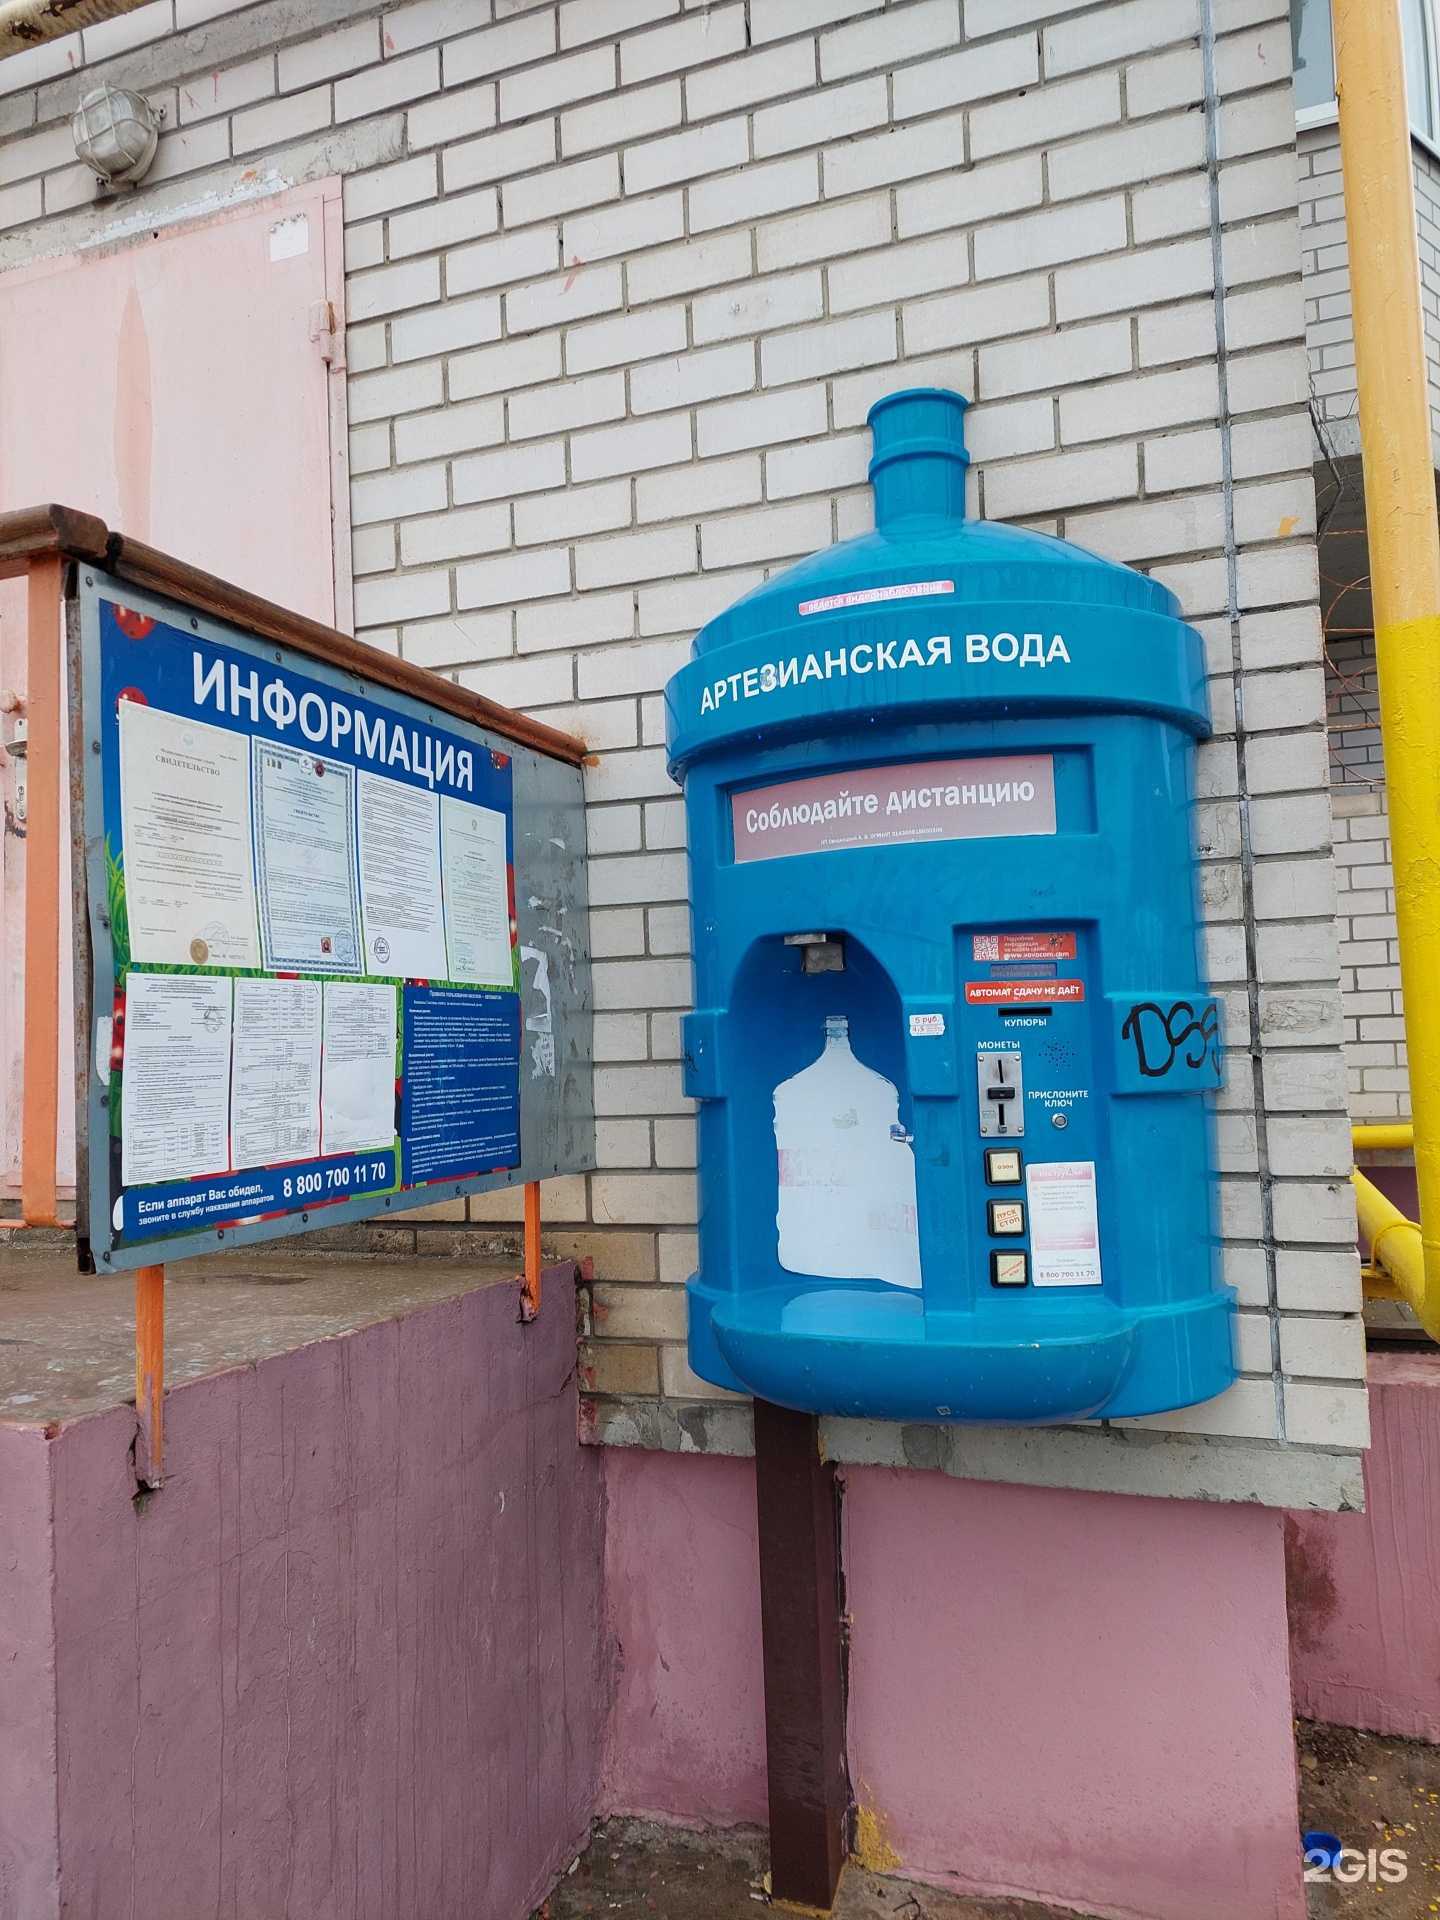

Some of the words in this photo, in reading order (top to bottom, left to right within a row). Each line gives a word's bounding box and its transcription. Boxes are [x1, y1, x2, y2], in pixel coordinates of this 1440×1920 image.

[700, 635, 951, 715] АРТЕЗИАНСКАЯ
[966, 633, 1071, 669] ВОДА
[192, 651, 474, 793] ИНФОРМАЦИЯ
[155, 754, 221, 776] СВИДЕТЕЛЬСТВО
[745, 788, 879, 835] Соблюдайте
[886, 776, 1035, 814] дистанцию
[969, 988, 1012, 998] АВТОМАТ
[1013, 987, 1043, 998] СДАЧУ
[1044, 986, 1056, 995] НЕ
[1057, 985, 1080, 996] ДАЁТ
[1004, 1018, 1047, 1028] КУПЮРЫ
[977, 1040, 1021, 1050] МОНЕТЫ
[1028, 1090, 1089, 1100] ПРИСЛОНИТЕ
[1044, 1098, 1073, 1108] КЛЮЧ
[282, 1177, 293, 1198] 8
[296, 1172, 322, 1195] 800
[326, 1167, 350, 1190] 700
[353, 1164, 367, 1184] 11
[370, 1161, 387, 1181] 70
[138, 1198, 165, 1214] Если
[166, 1192, 206, 1208] аппарат
[208, 1188, 227, 1201] Вас
[228, 1183, 264, 1200] обидел,
[138, 1213, 170, 1226] звоните
[170, 1211, 177, 1221] в
[177, 1206, 204, 1221] службу
[205, 1200, 240, 1213] наказания
[240, 1194, 275, 1208] аппаратов
